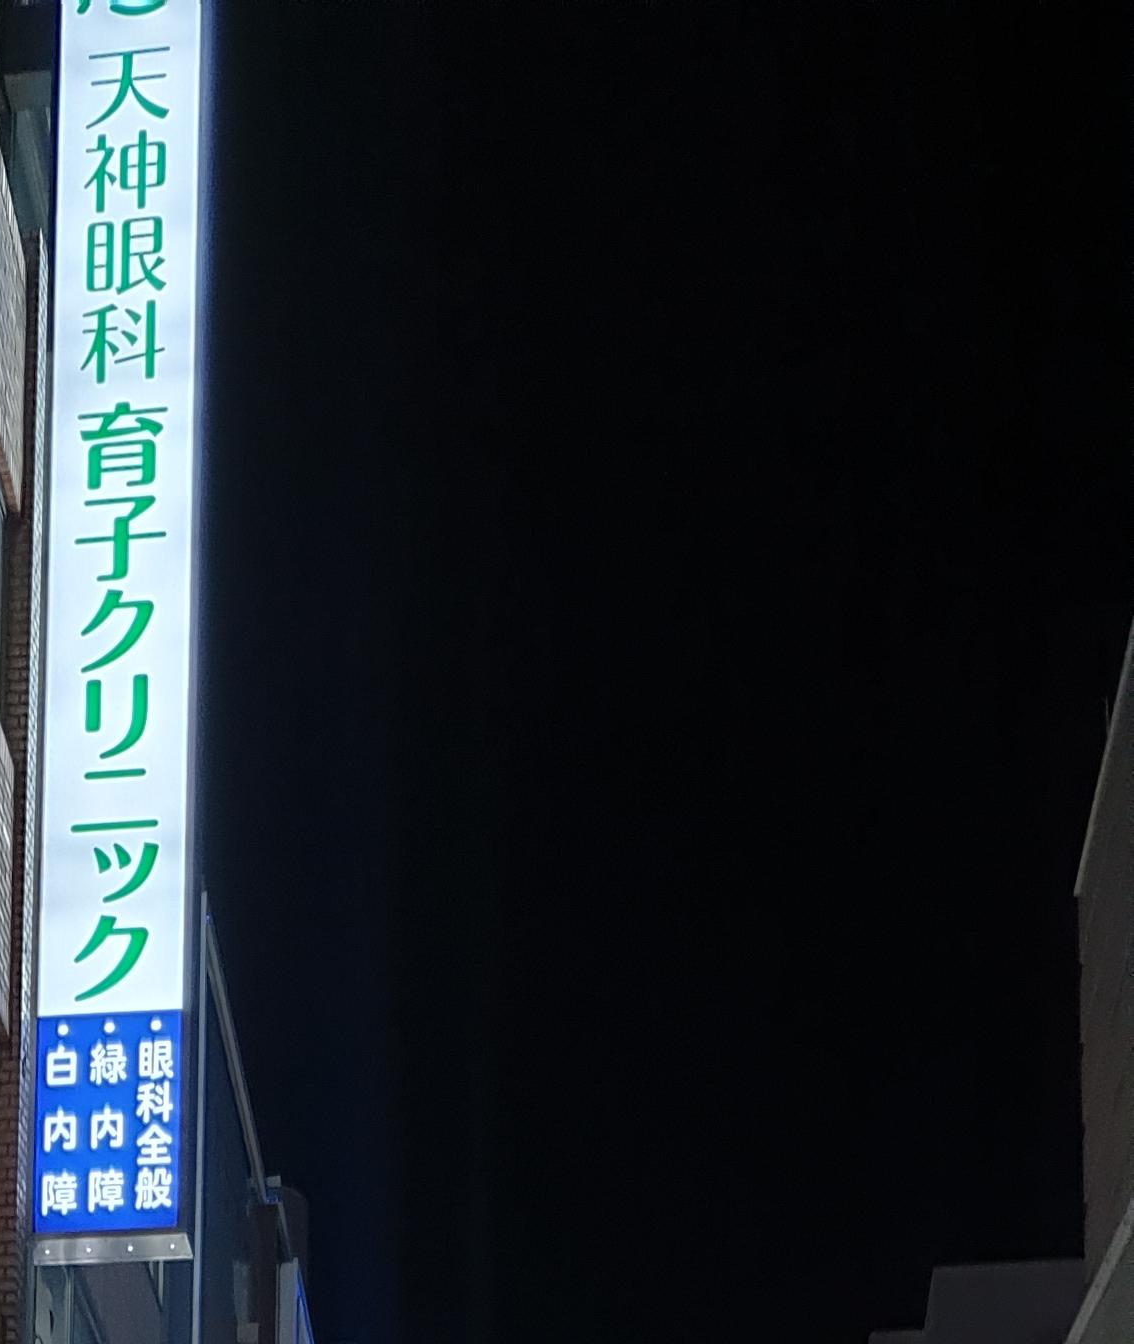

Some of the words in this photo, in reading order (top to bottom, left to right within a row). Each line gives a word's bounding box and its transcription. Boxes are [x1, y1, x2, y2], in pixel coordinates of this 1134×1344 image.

[40, 1043, 80, 1217] 白内障
[87, 1041, 127, 1214] 緑内障
[134, 1038, 174, 1213] 眼科全般
